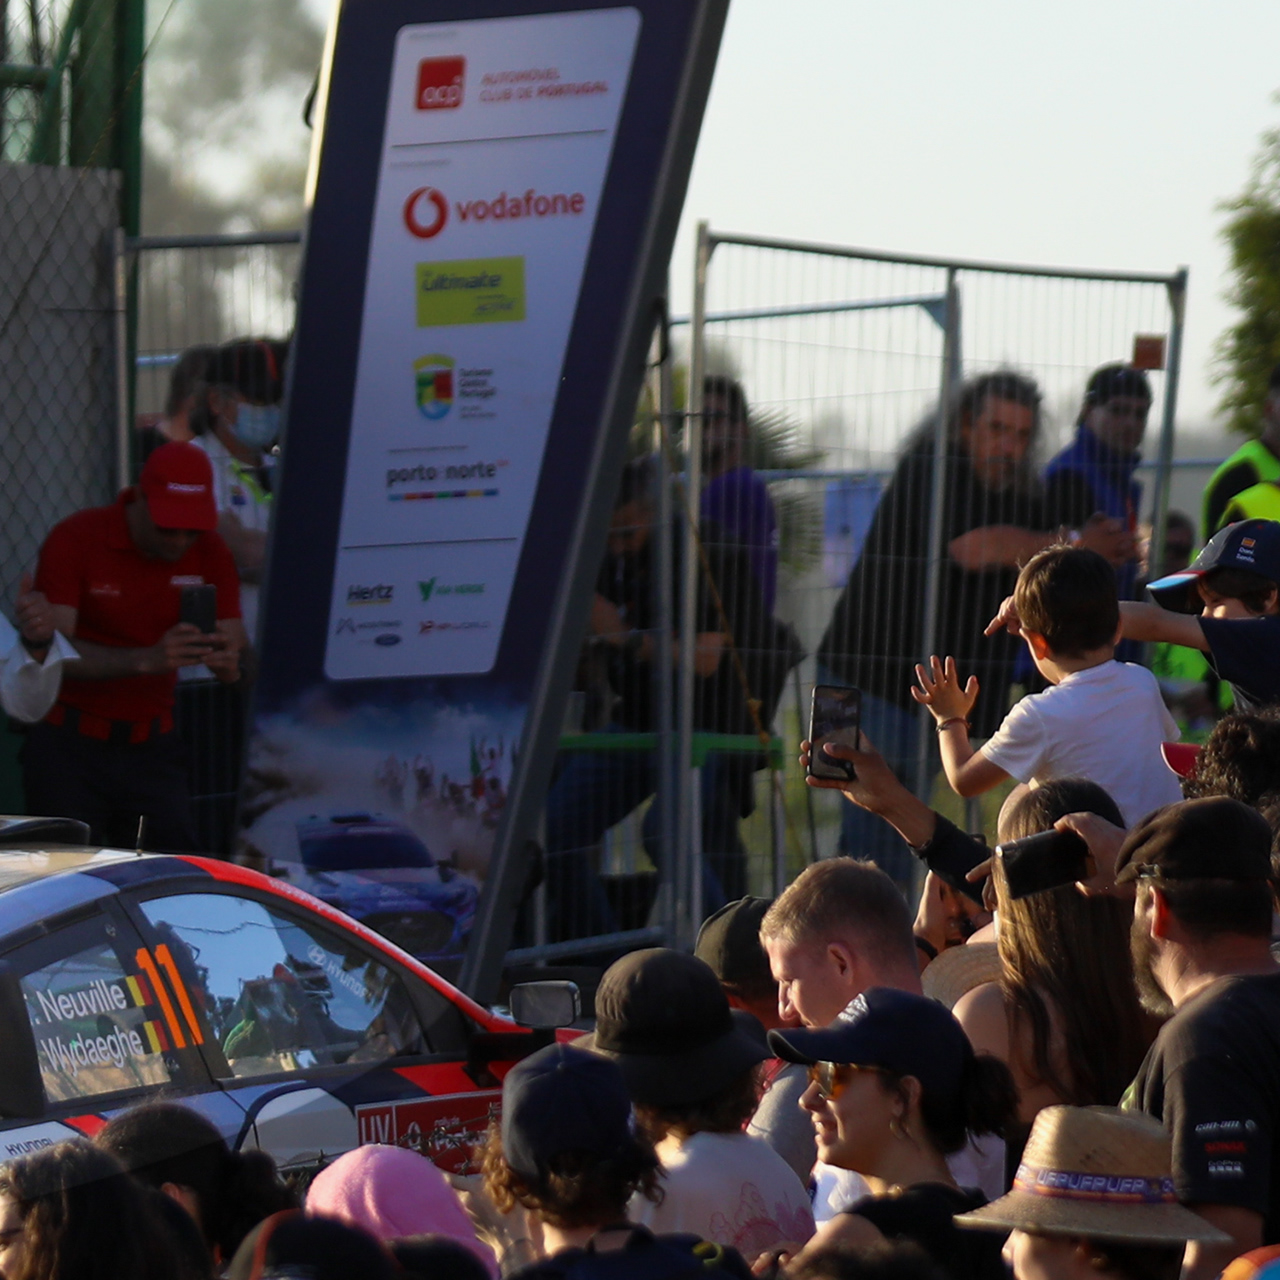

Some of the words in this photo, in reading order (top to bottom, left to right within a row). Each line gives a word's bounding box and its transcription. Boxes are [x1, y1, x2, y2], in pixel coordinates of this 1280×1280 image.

[536, 80, 608, 97] PORTUGAL
[455, 189, 585, 221] vodafone
[386, 465, 437, 488] porto
[445, 461, 497, 479] norte
[348, 583, 395, 600] Hertz
[36, 978, 128, 1023] Neuville
[135, 942, 206, 1050] 11
[40, 1024, 145, 1078] Wydaeghe
